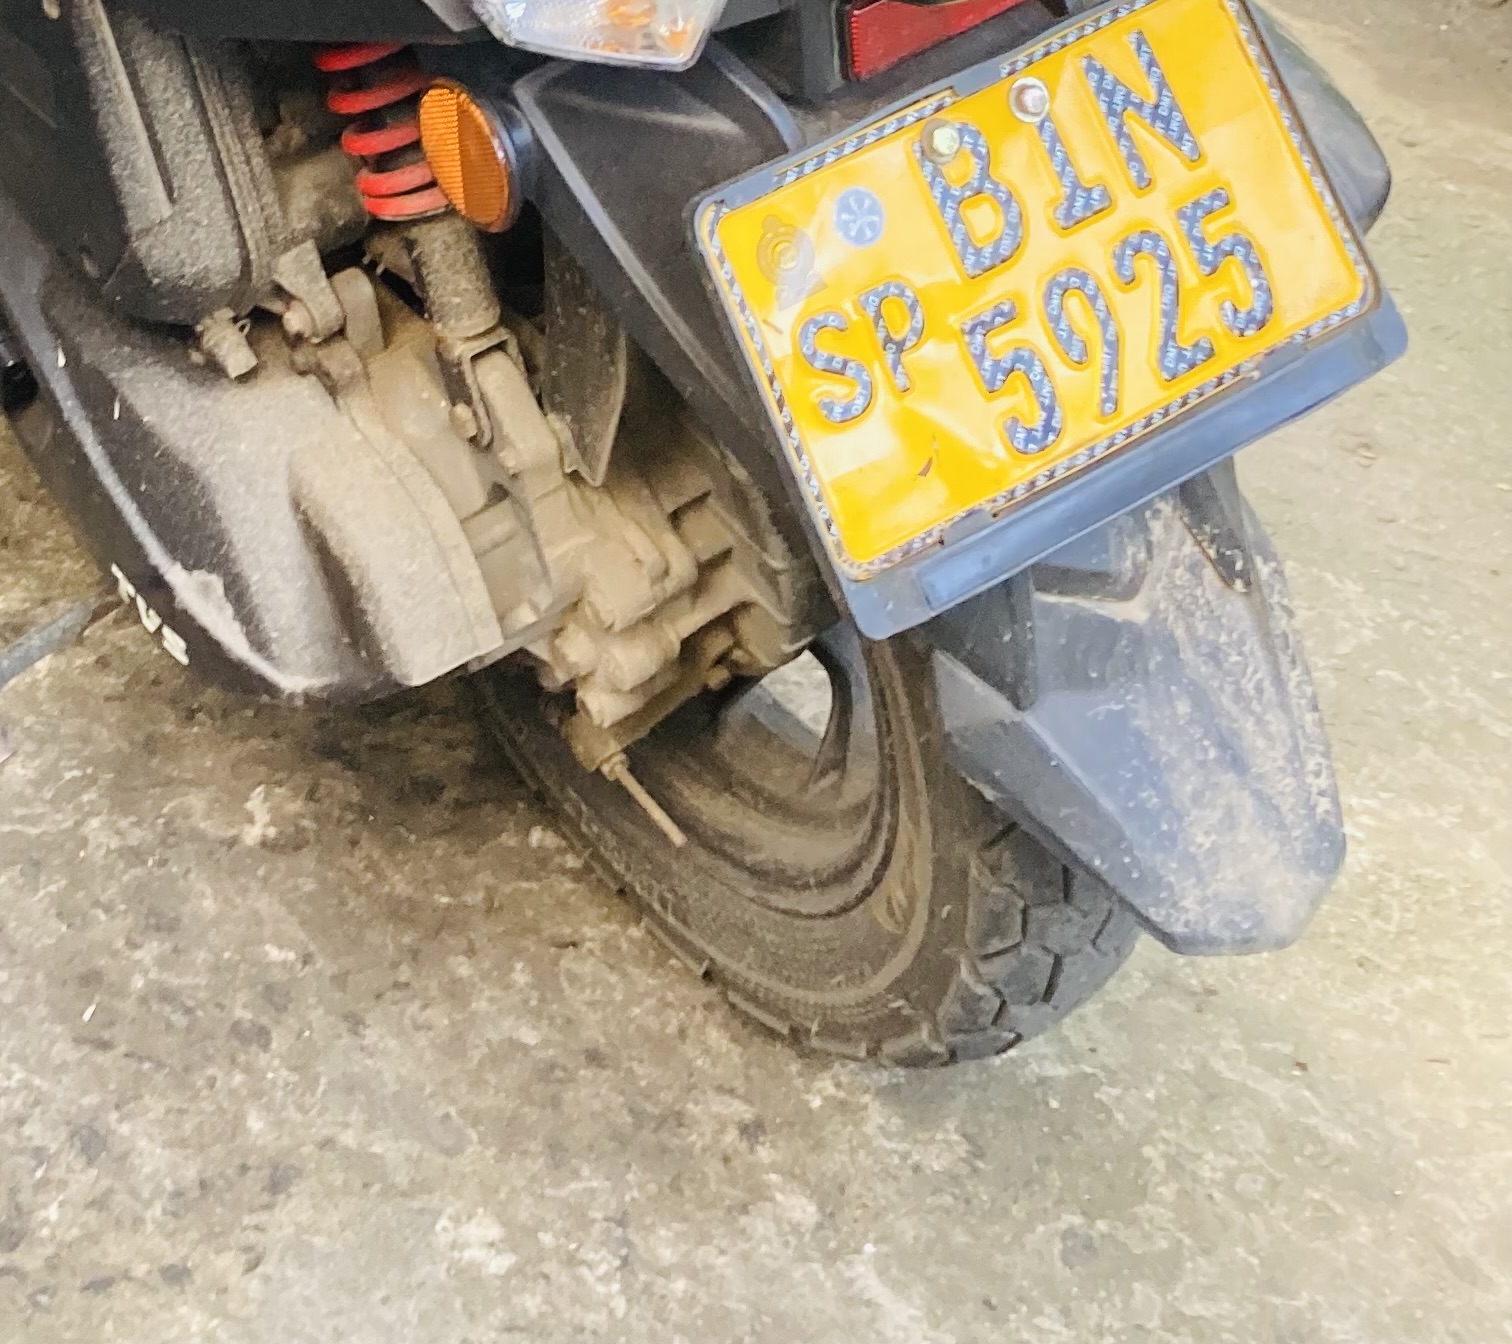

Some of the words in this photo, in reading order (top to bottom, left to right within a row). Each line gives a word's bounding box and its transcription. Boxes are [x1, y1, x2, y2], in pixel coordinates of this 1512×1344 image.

[801, 283, 925, 422] SP
[962, 187, 1273, 454] 5925
[110, 562, 190, 666] TVS
